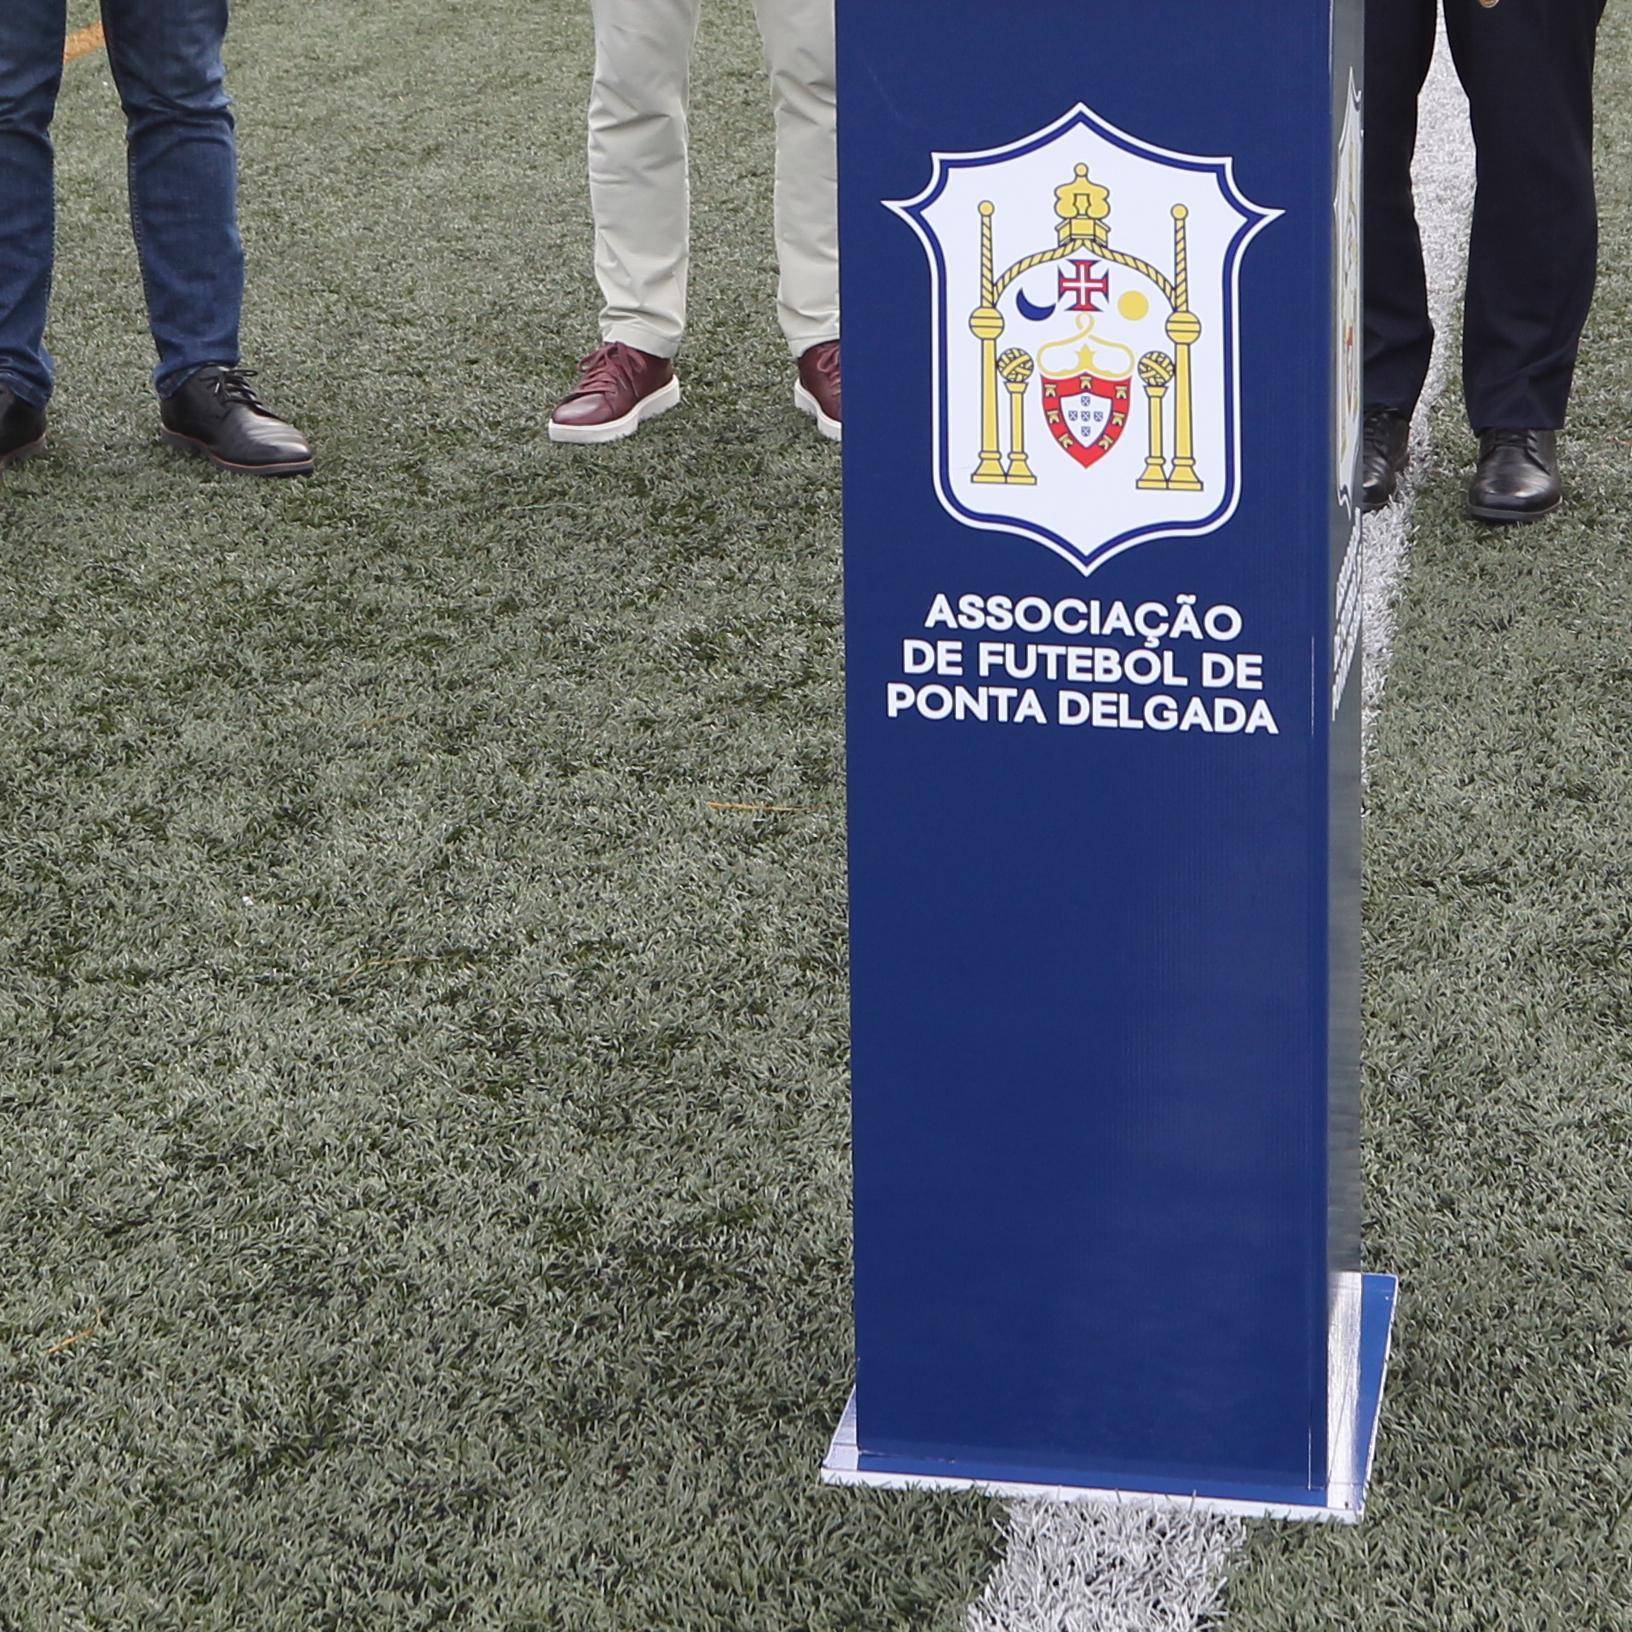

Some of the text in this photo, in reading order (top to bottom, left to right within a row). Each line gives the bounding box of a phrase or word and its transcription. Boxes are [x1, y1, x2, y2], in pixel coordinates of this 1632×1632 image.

[924, 593, 1242, 649] ASSOCIAÇÃO
[903, 639, 1263, 690] DE FUTEBOL DE
[886, 682, 1279, 734] PONTA DELGADA
